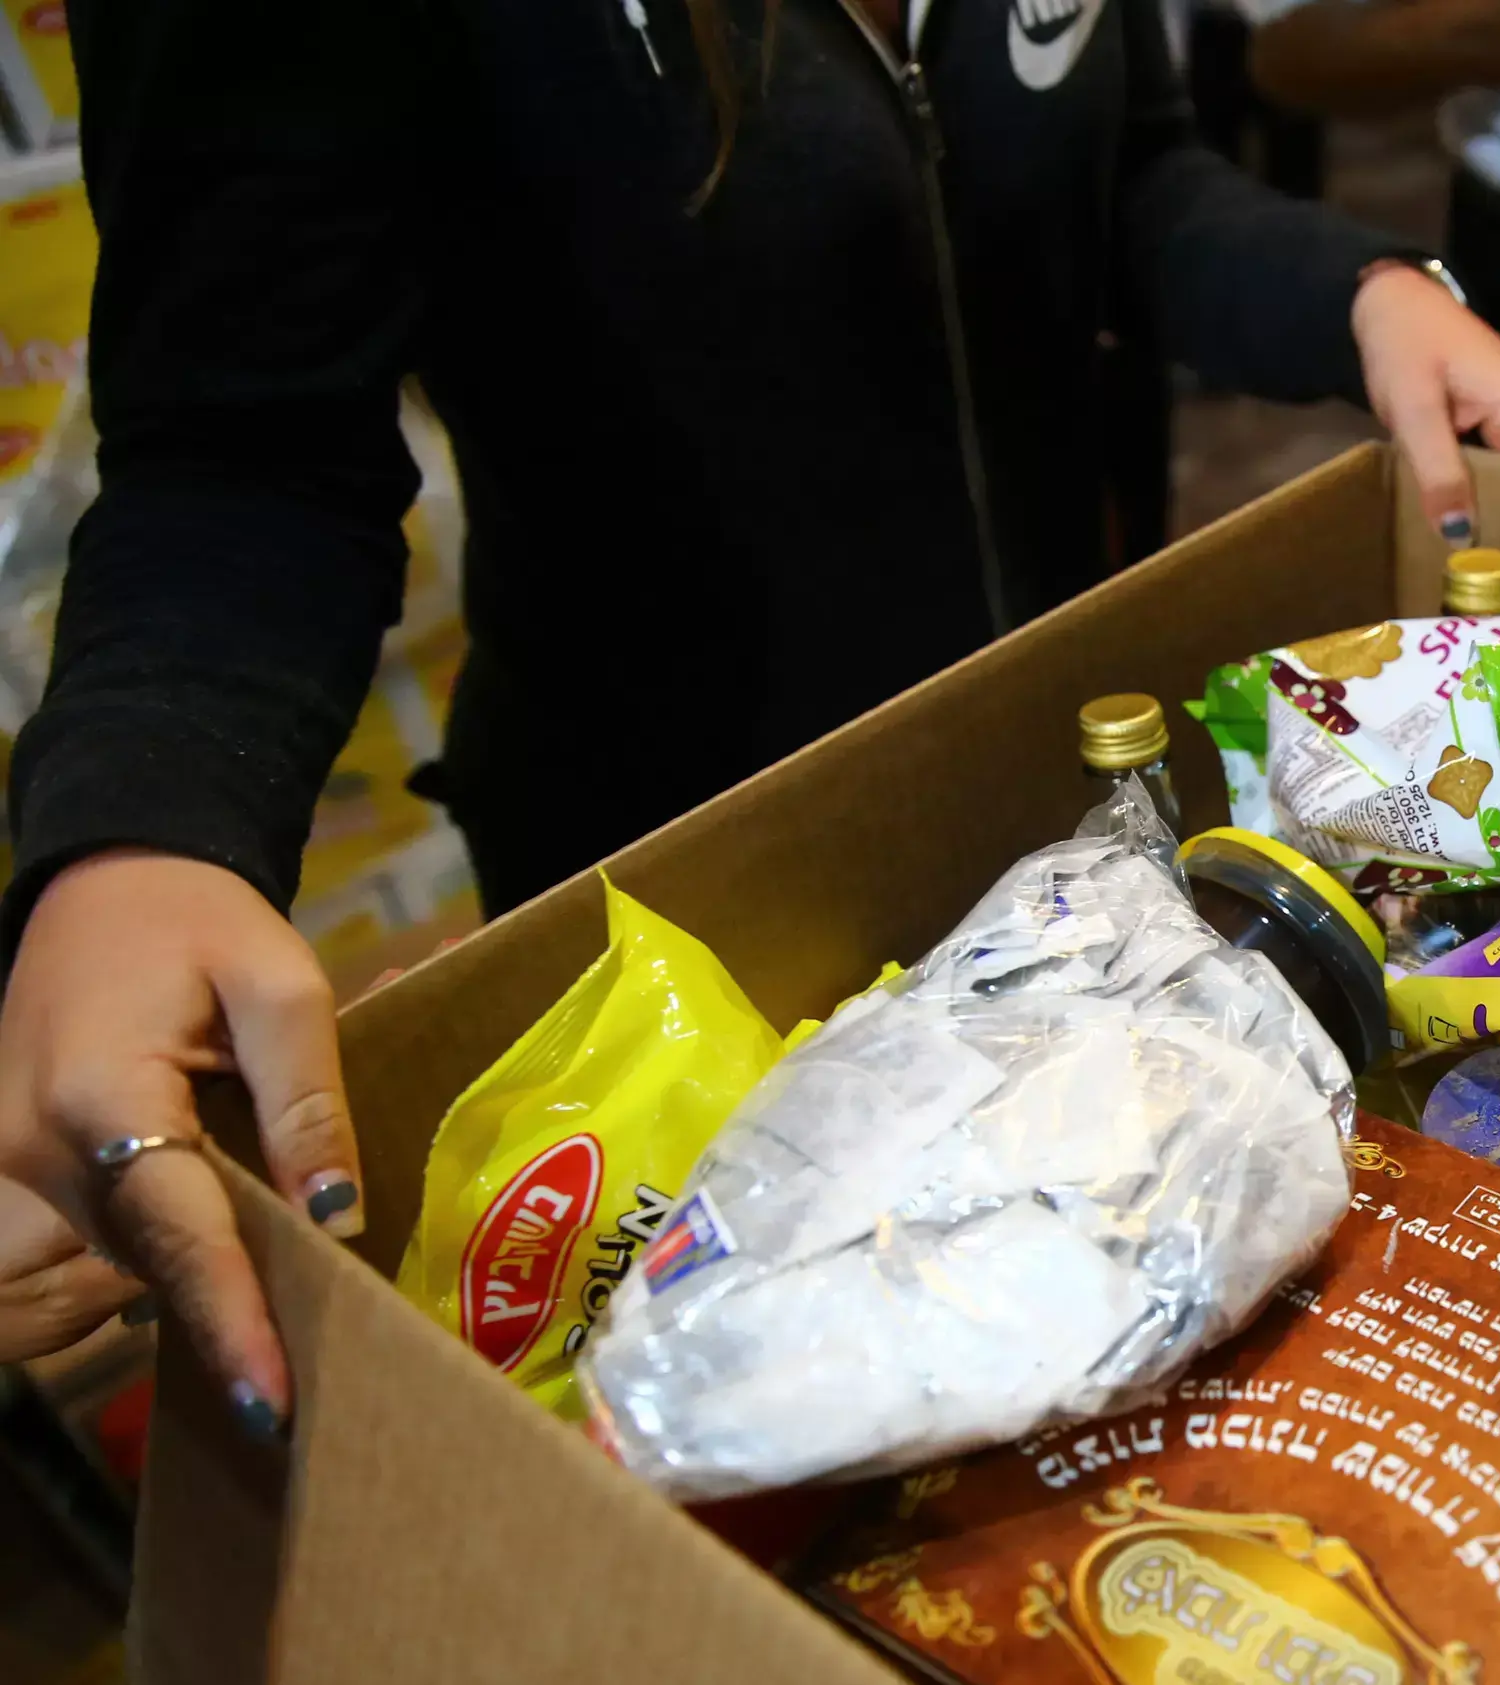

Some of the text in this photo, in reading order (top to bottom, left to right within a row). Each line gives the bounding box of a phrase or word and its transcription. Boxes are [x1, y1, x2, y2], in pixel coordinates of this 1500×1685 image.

[1385, 803, 1401, 824] for
[1398, 795, 1419, 825] 350
[1408, 782, 1432, 821] 12.25
[1400, 1218, 1487, 1260] שקיות
[1404, 1278, 1489, 1323] הופרשה
[1326, 1308, 1395, 1345] לפסח
[1356, 1289, 1402, 1314] ללא
[1402, 1307, 1456, 1339] חשש
[1459, 1331, 1500, 1362] טבל
[1396, 1372, 1456, 1410] מצת
[1299, 1388, 1394, 1429] מסורת
[1395, 1422, 1439, 1456] של
[1037, 1419, 1163, 1487] מצות
[1186, 1416, 1325, 1462] מכונה
[1332, 1442, 1479, 1536] שמורה
